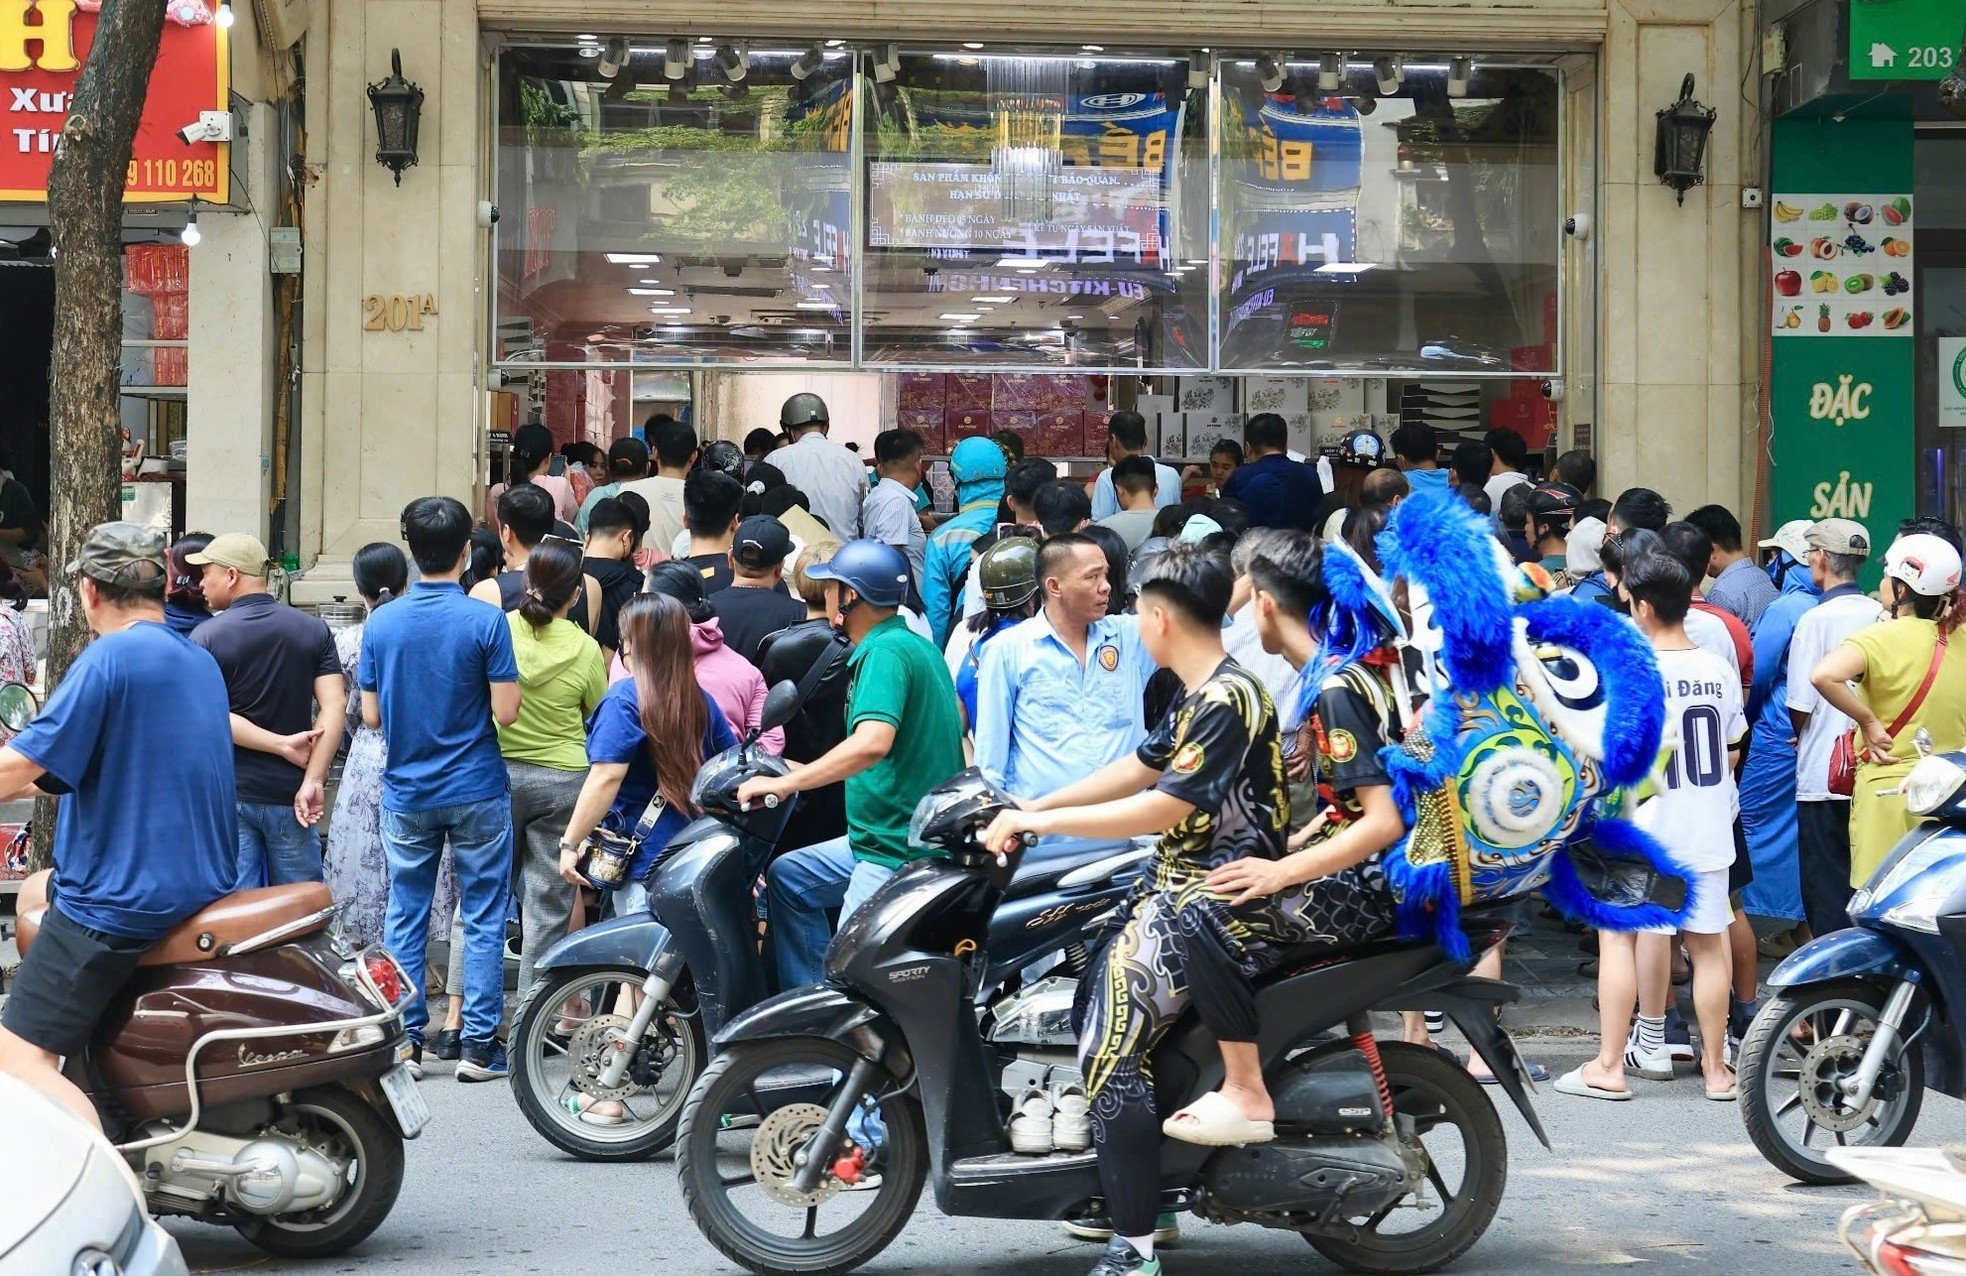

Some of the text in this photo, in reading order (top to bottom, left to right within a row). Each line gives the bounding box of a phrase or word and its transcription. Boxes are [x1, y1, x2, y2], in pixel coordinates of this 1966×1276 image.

[1907, 47, 1953, 68] 203
[144, 159, 177, 187] 110
[182, 159, 215, 188] 268
[970, 171, 1002, 184] KHÔN
[363, 293, 439, 332] 201A
[1809, 374, 1873, 427] ĐẶC
[1809, 470, 1873, 519] SẢN
[1677, 680, 1723, 699] Đăng
[888, 965, 931, 981] SPORTY
[237, 1042, 310, 1068] Vespa
